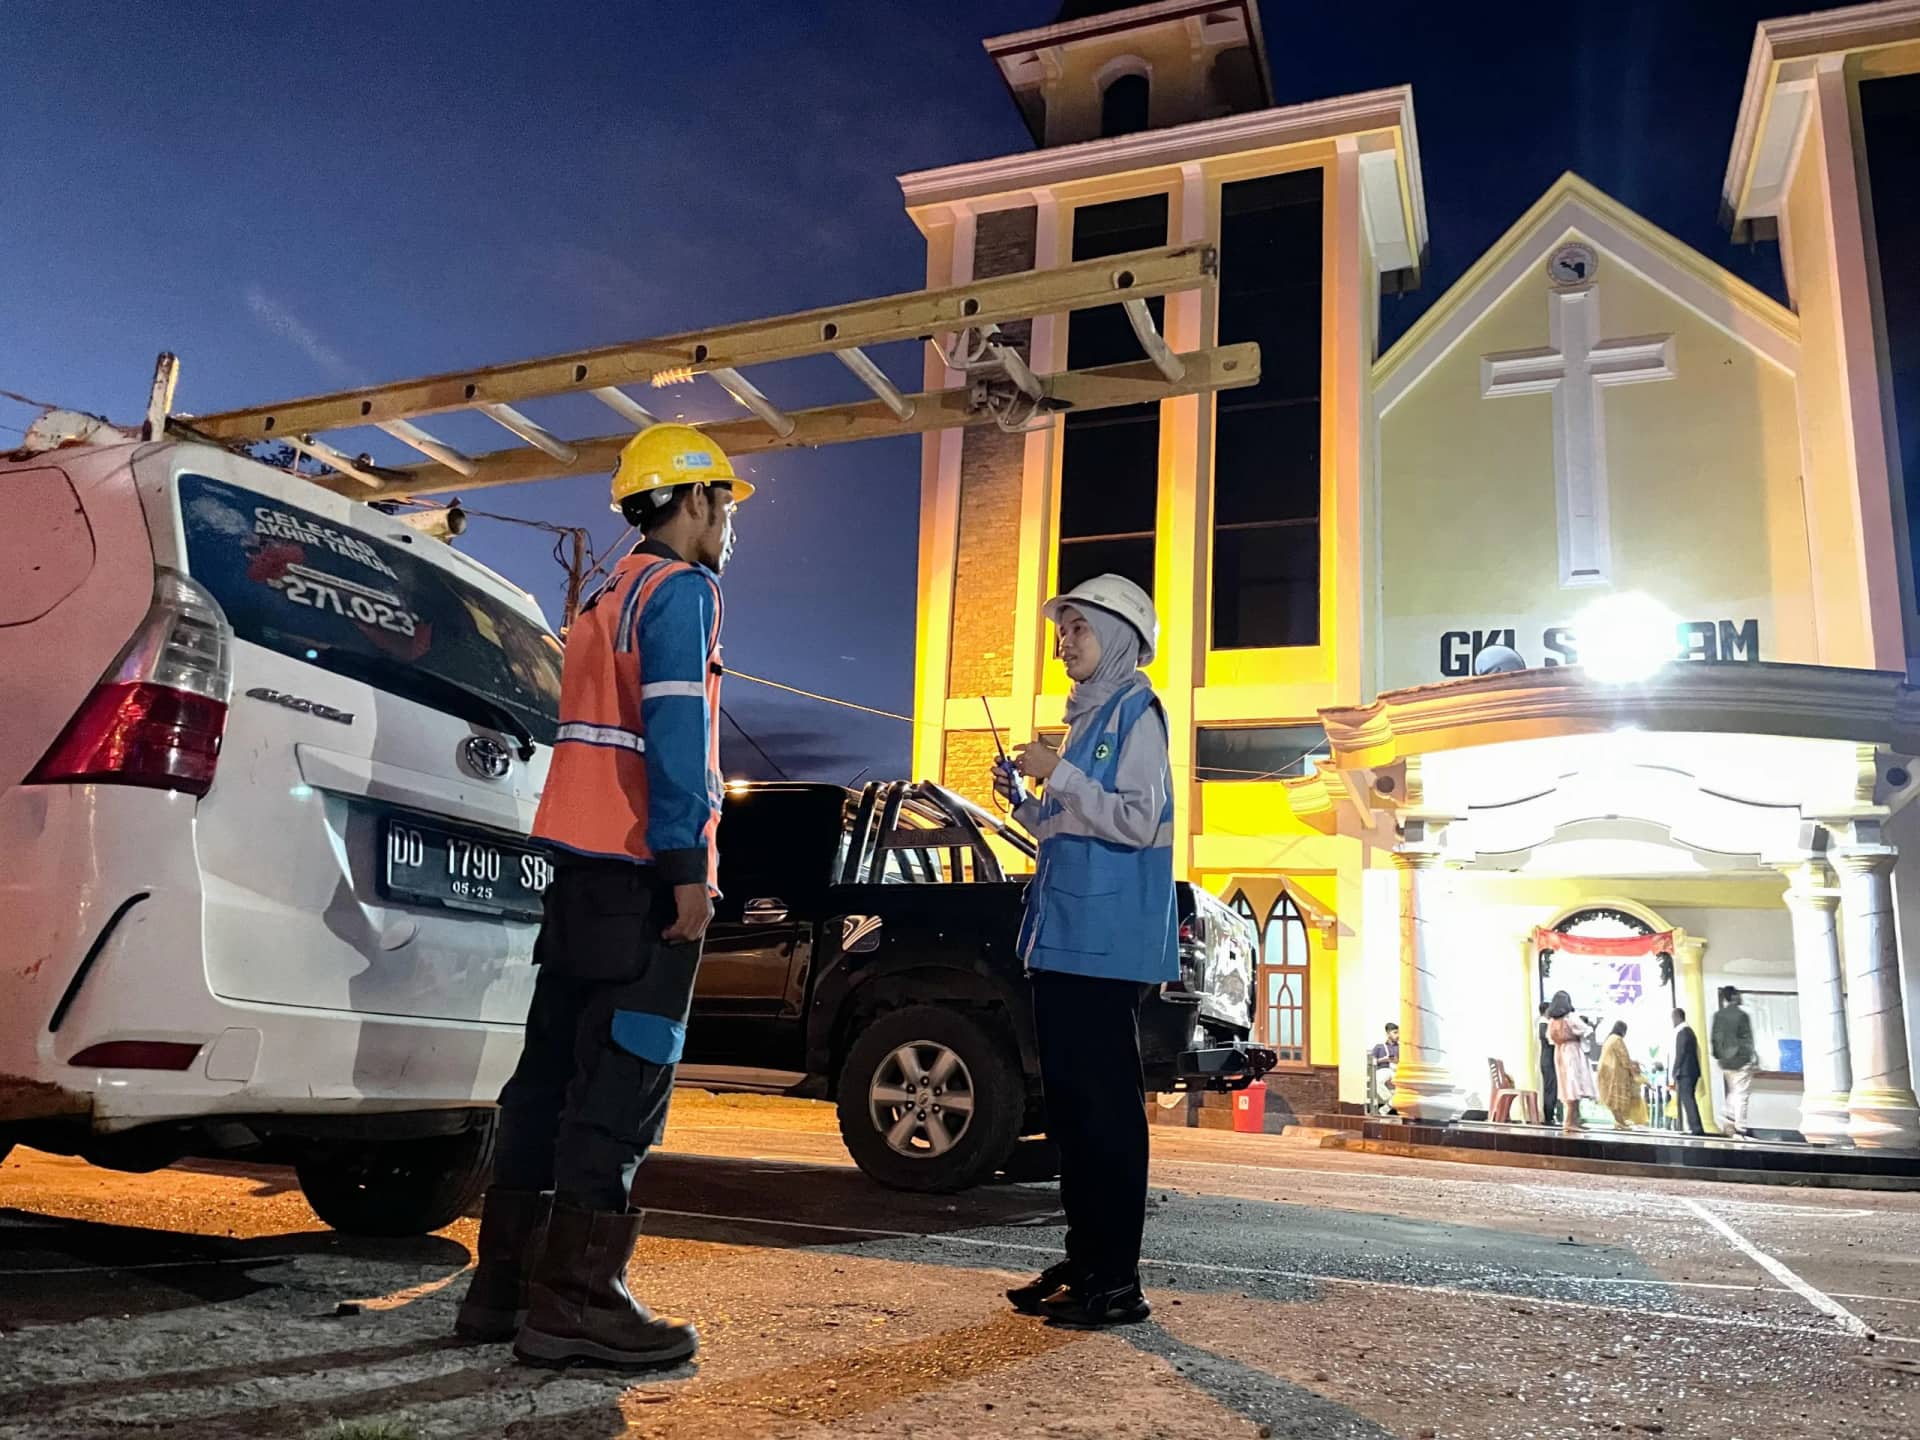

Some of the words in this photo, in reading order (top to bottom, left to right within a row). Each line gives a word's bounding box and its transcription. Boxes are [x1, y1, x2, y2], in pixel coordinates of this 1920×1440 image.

[254, 520, 322, 547] AKHIR
[394, 827, 423, 867] DD
[447, 838, 500, 882] 1790
